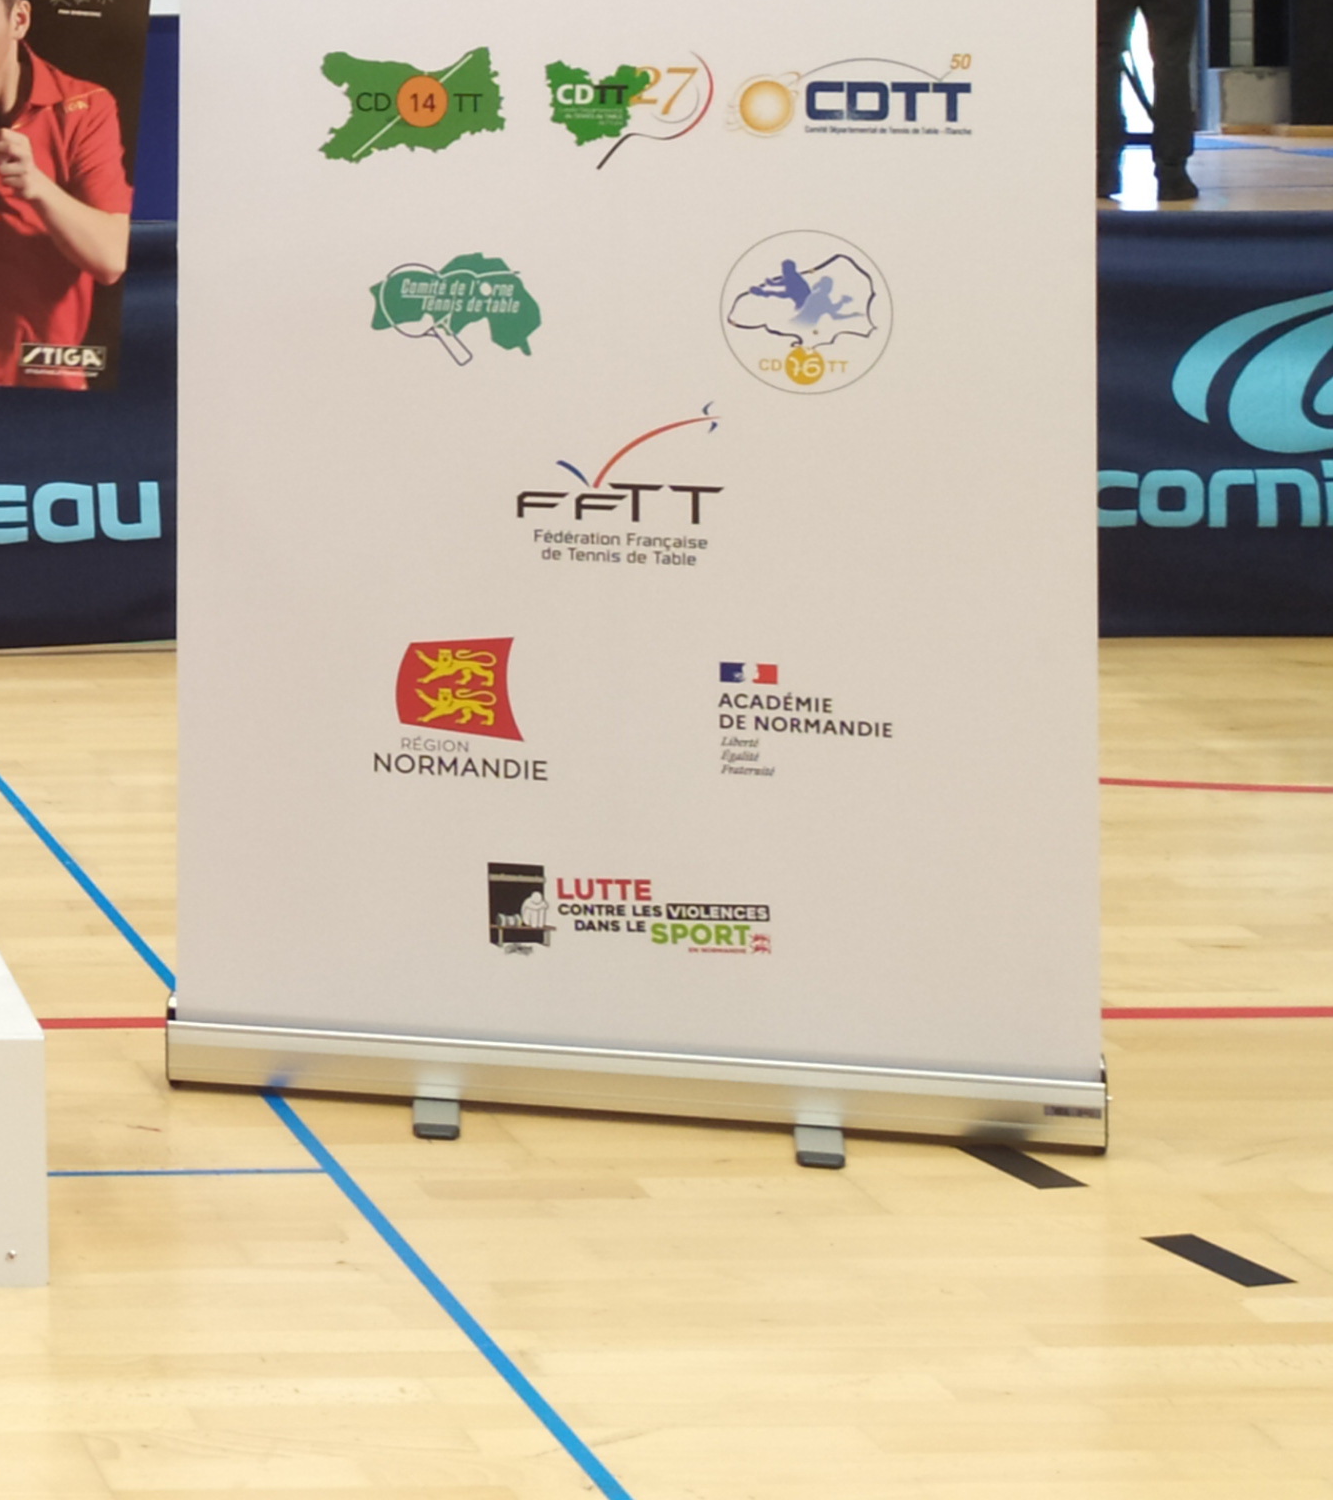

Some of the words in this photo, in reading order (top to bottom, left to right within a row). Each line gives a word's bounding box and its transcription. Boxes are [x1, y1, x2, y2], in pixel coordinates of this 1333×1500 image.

[950, 54, 971, 70] 50
[556, 84, 628, 105] CDTT
[629, 65, 698, 115] 27
[356, 92, 392, 111] CD
[410, 93, 436, 112] 14
[453, 93, 483, 112] TT
[806, 81, 971, 122] CDTT
[401, 278, 447, 294] Comité
[450, 280, 466, 296] de
[466, 298, 483, 312] de
[485, 297, 521, 313] table
[23, 346, 103, 367] STIGA
[758, 359, 782, 371] CD
[788, 356, 822, 377] 76
[827, 361, 849, 373] TT
[517, 483, 724, 525] FFTT
[533, 529, 621, 547] Fédération
[626, 533, 708, 551] Française
[541, 547, 562, 560] de
[568, 547, 621, 563] Tennis
[627, 551, 647, 564] de
[653, 551, 697, 566] Table
[718, 691, 833, 713] ACADÉMIE
[719, 714, 746, 730] DE
[754, 715, 893, 738] NORMANDIE
[401, 736, 469, 752] RÉGION
[721, 736, 759, 748] Liberté
[374, 752, 548, 781] NORMANDIE
[721, 749, 759, 763] Égalité
[721, 764, 775, 777] Fraternité
[556, 878, 652, 901] LUTTE
[557, 903, 626, 917] CONTRE
[633, 905, 663, 918] LES
[668, 905, 769, 921] VIOLENCES
[575, 920, 620, 932] DANS
[627, 921, 646, 932] LE
[651, 923, 751, 946] SPORT
